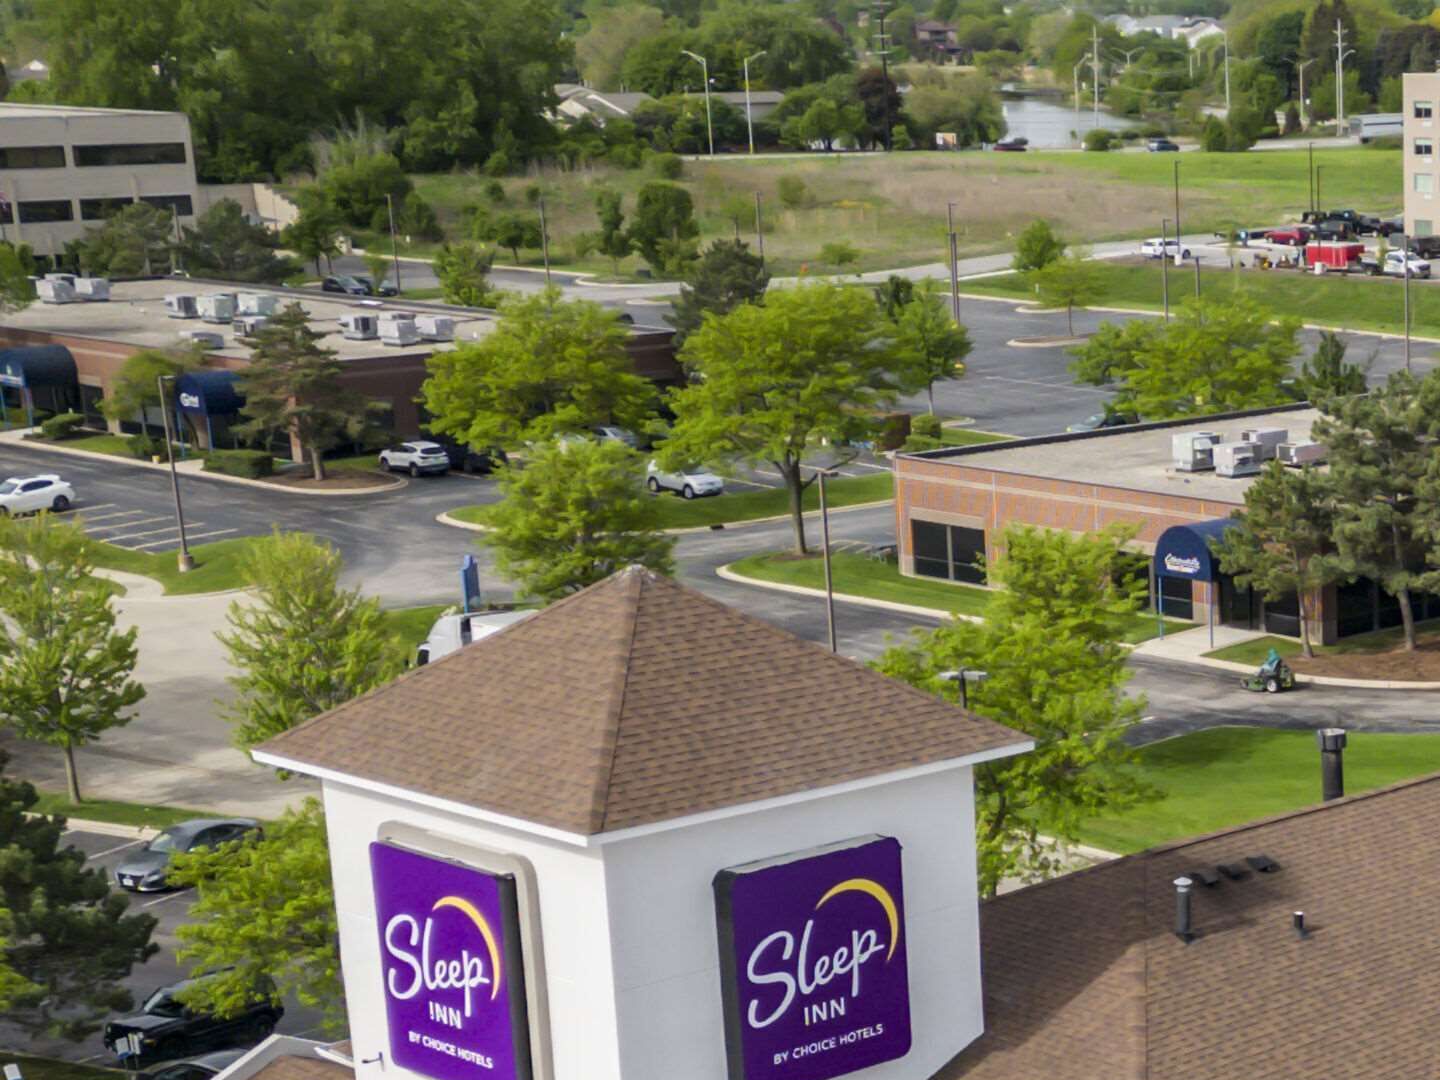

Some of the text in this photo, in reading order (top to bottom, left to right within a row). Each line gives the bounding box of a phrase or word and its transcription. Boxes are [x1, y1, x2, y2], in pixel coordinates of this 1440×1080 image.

[385, 914, 490, 1017] Sleep
[747, 920, 885, 1029] Sleep
[429, 1000, 462, 1030] INN
[804, 997, 846, 1026] INN
[408, 1031, 494, 1069] BY CHOICE HOTELS
[773, 1024, 884, 1065] BY CHOICE HOTELS
